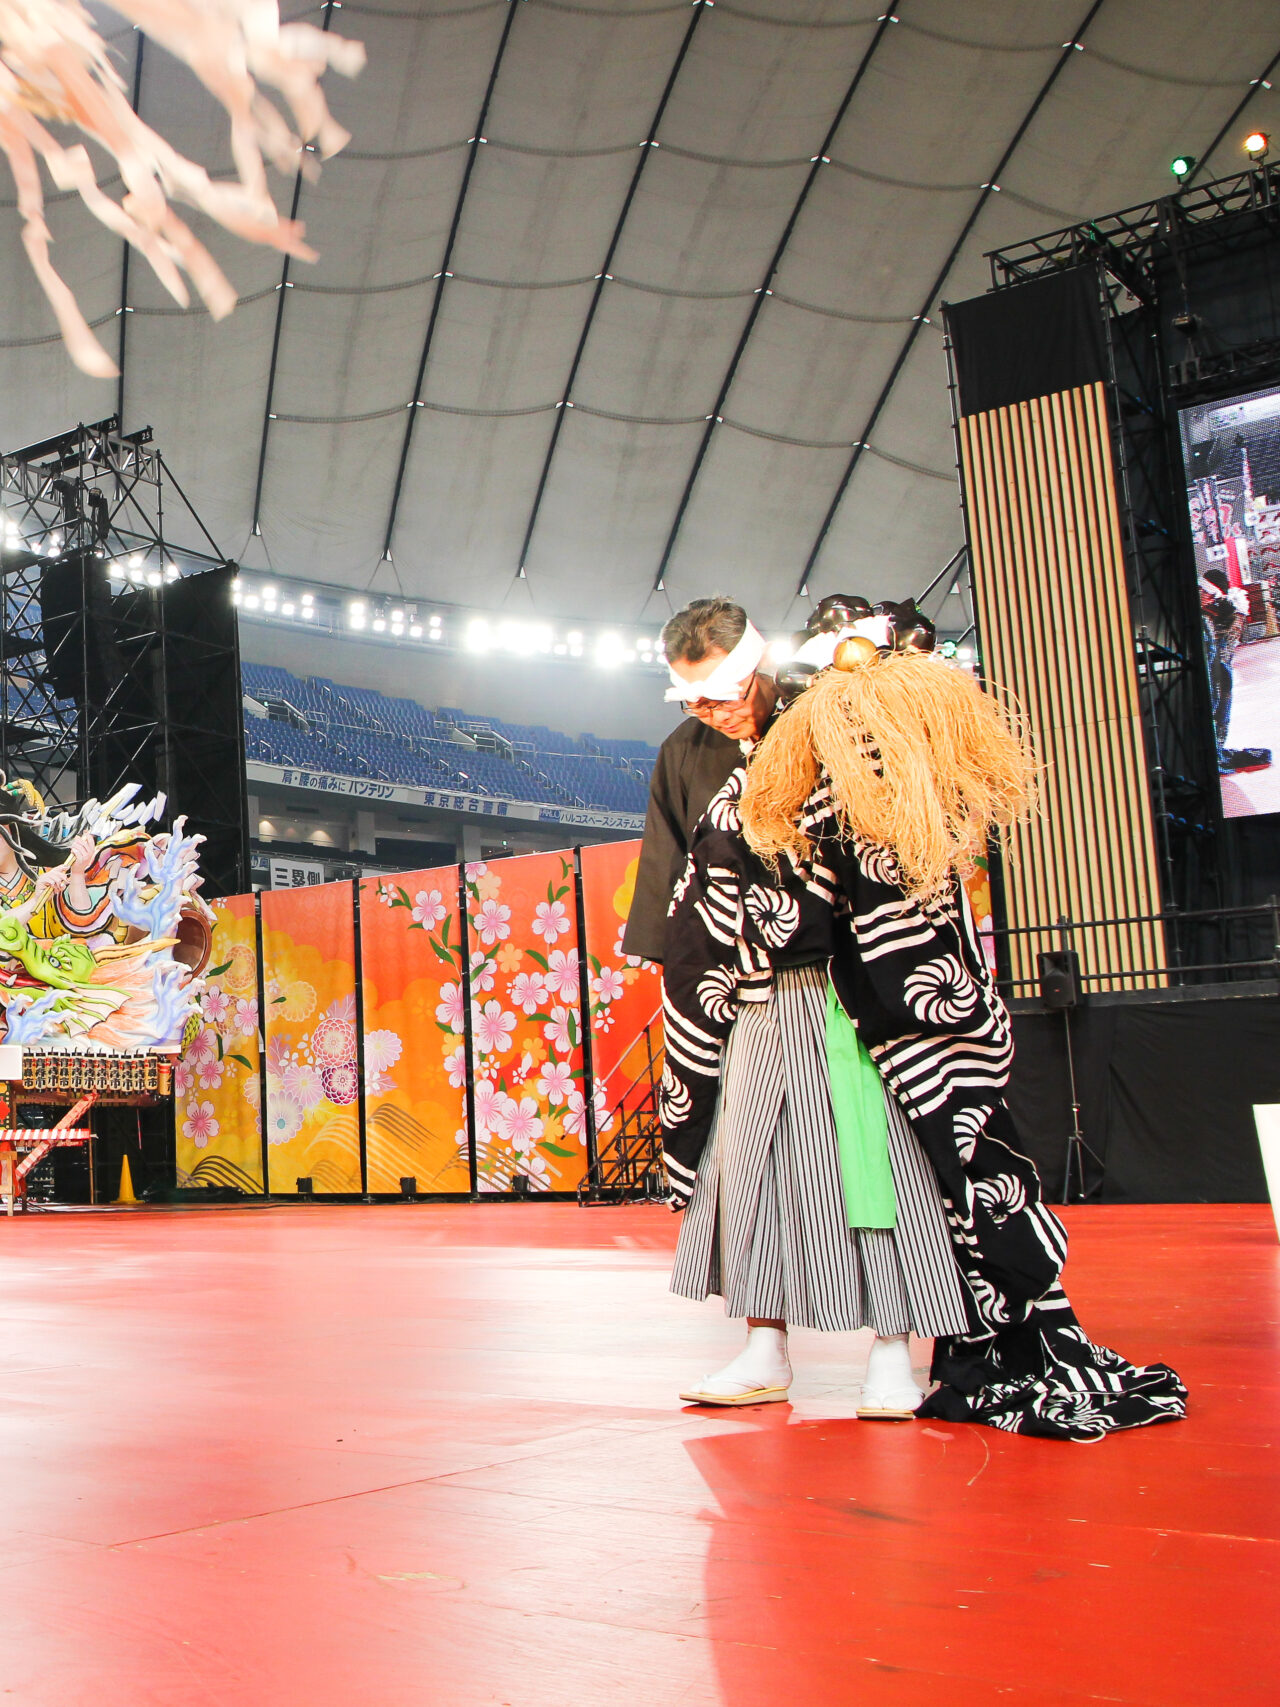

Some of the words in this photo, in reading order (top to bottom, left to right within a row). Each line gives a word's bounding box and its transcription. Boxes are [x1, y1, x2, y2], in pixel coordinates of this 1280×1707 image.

[349, 780, 395, 799] バンテリン
[275, 867, 321, 888] 三塁側
